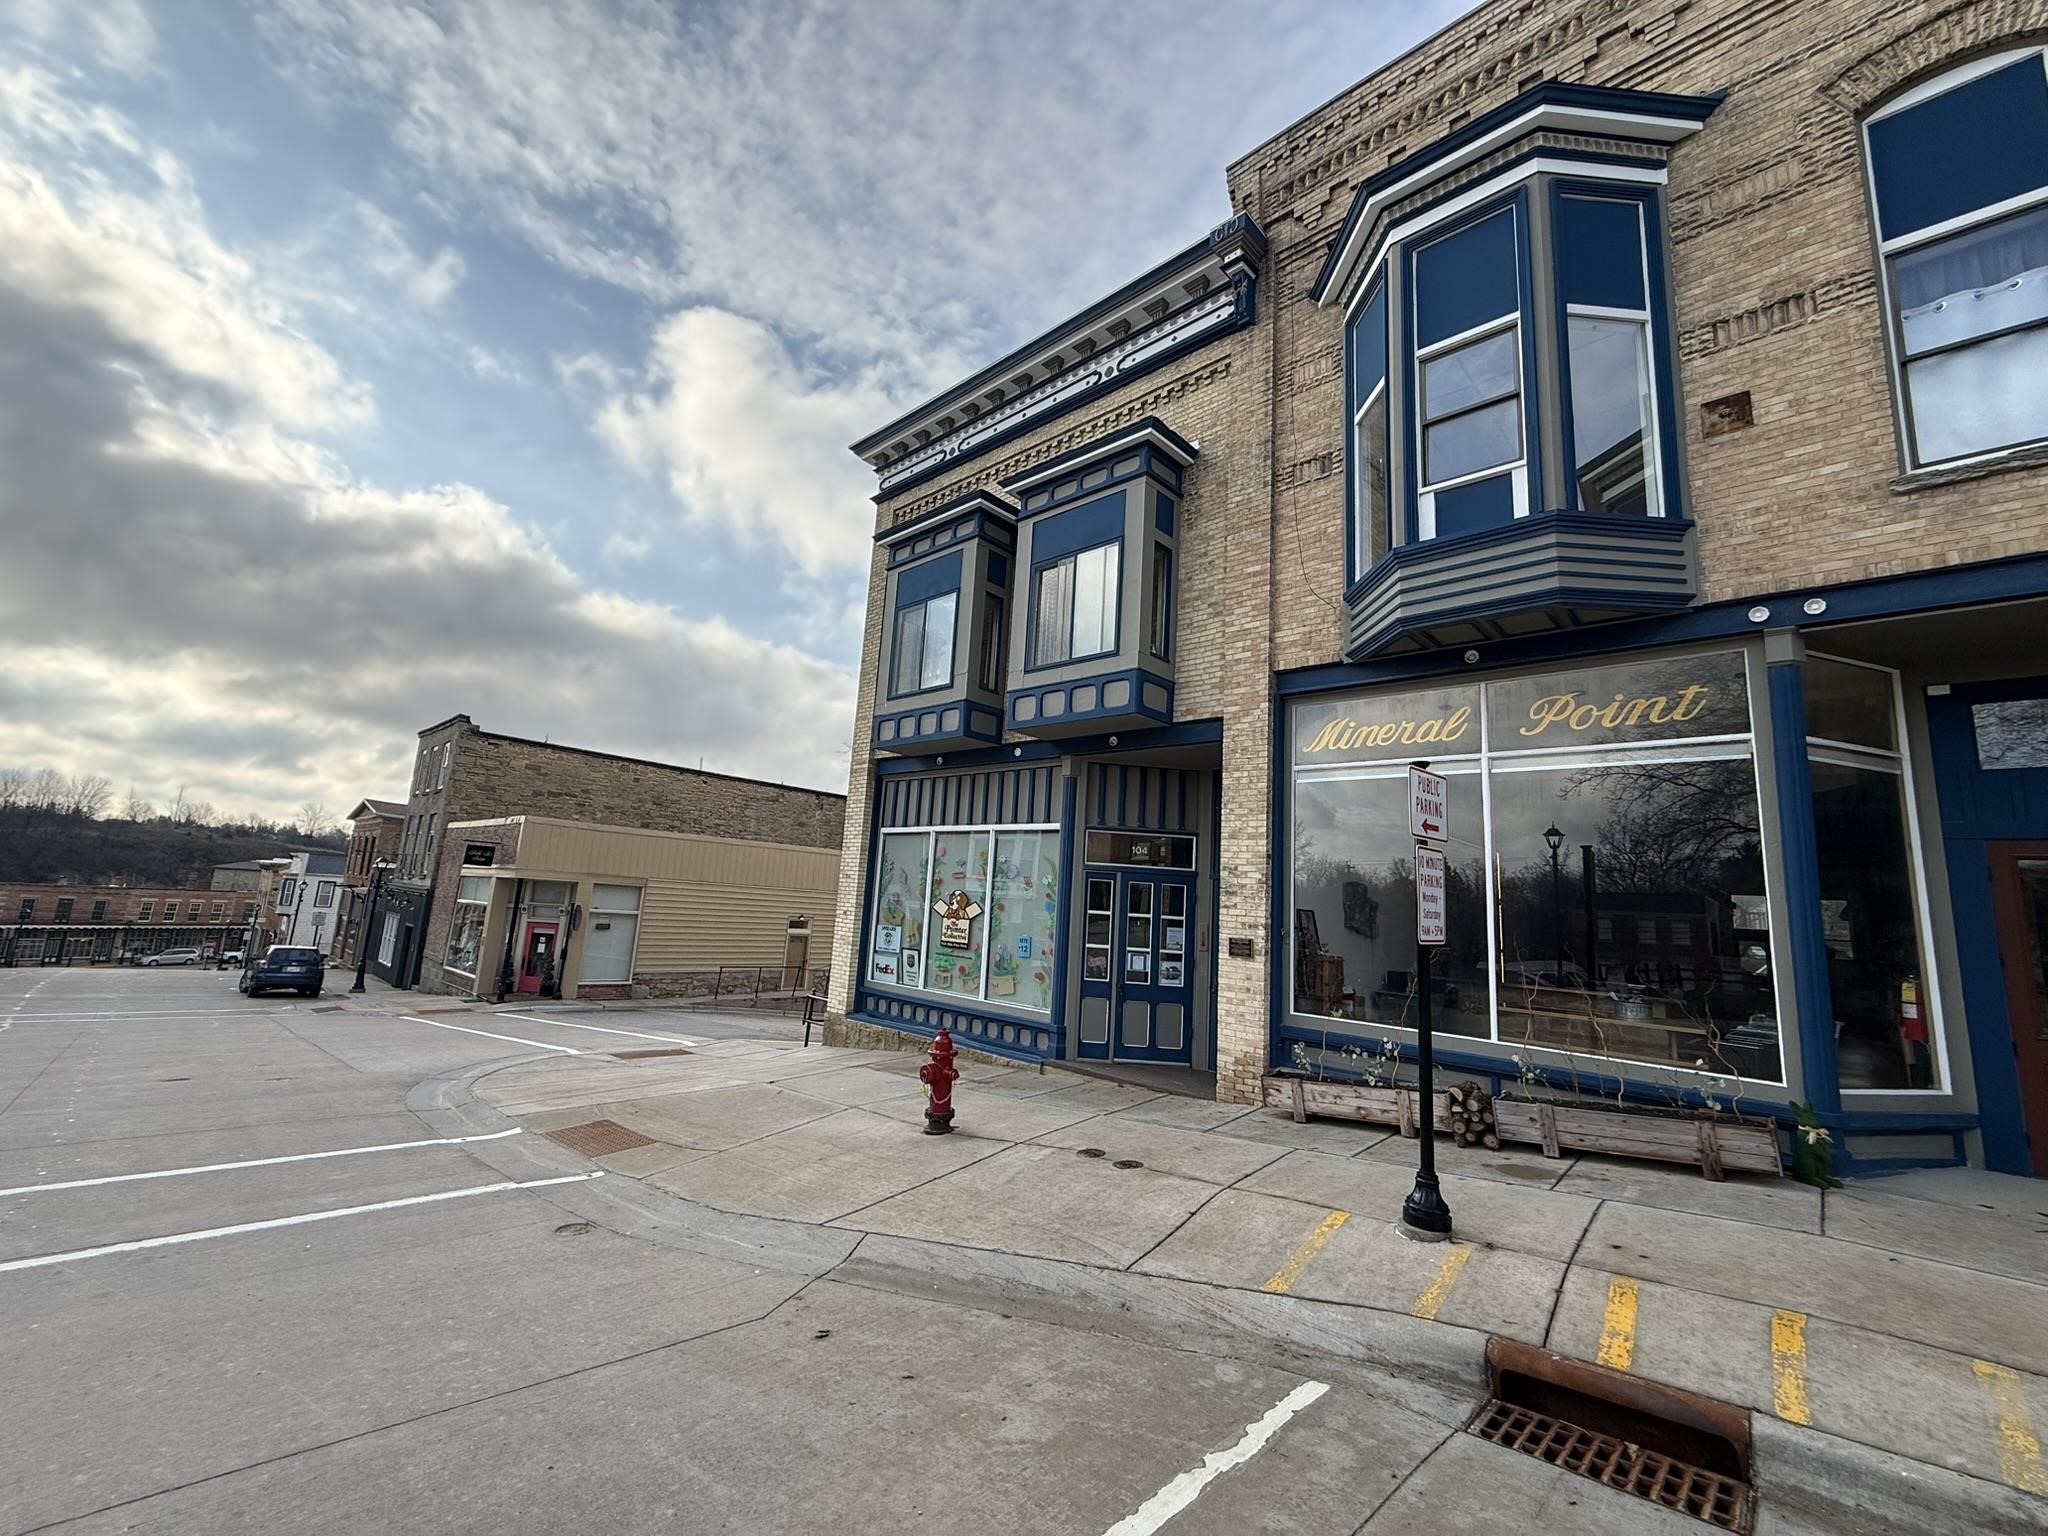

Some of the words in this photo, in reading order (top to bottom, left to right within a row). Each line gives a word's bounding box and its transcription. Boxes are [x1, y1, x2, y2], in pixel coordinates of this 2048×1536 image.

[1303, 705, 1471, 753] Mineral
[1520, 684, 1708, 737] Point
[1417, 775, 1441, 797] PUBLIC
[1415, 796, 1443, 819] PARKING
[1131, 845, 1148, 855] 104
[1426, 856, 1443, 871] MINUTE
[1420, 873, 1443, 889] PARKING
[1422, 891, 1438, 906] Monday
[1423, 908, 1441, 922] Saturday
[875, 963, 895, 975] FedEx
